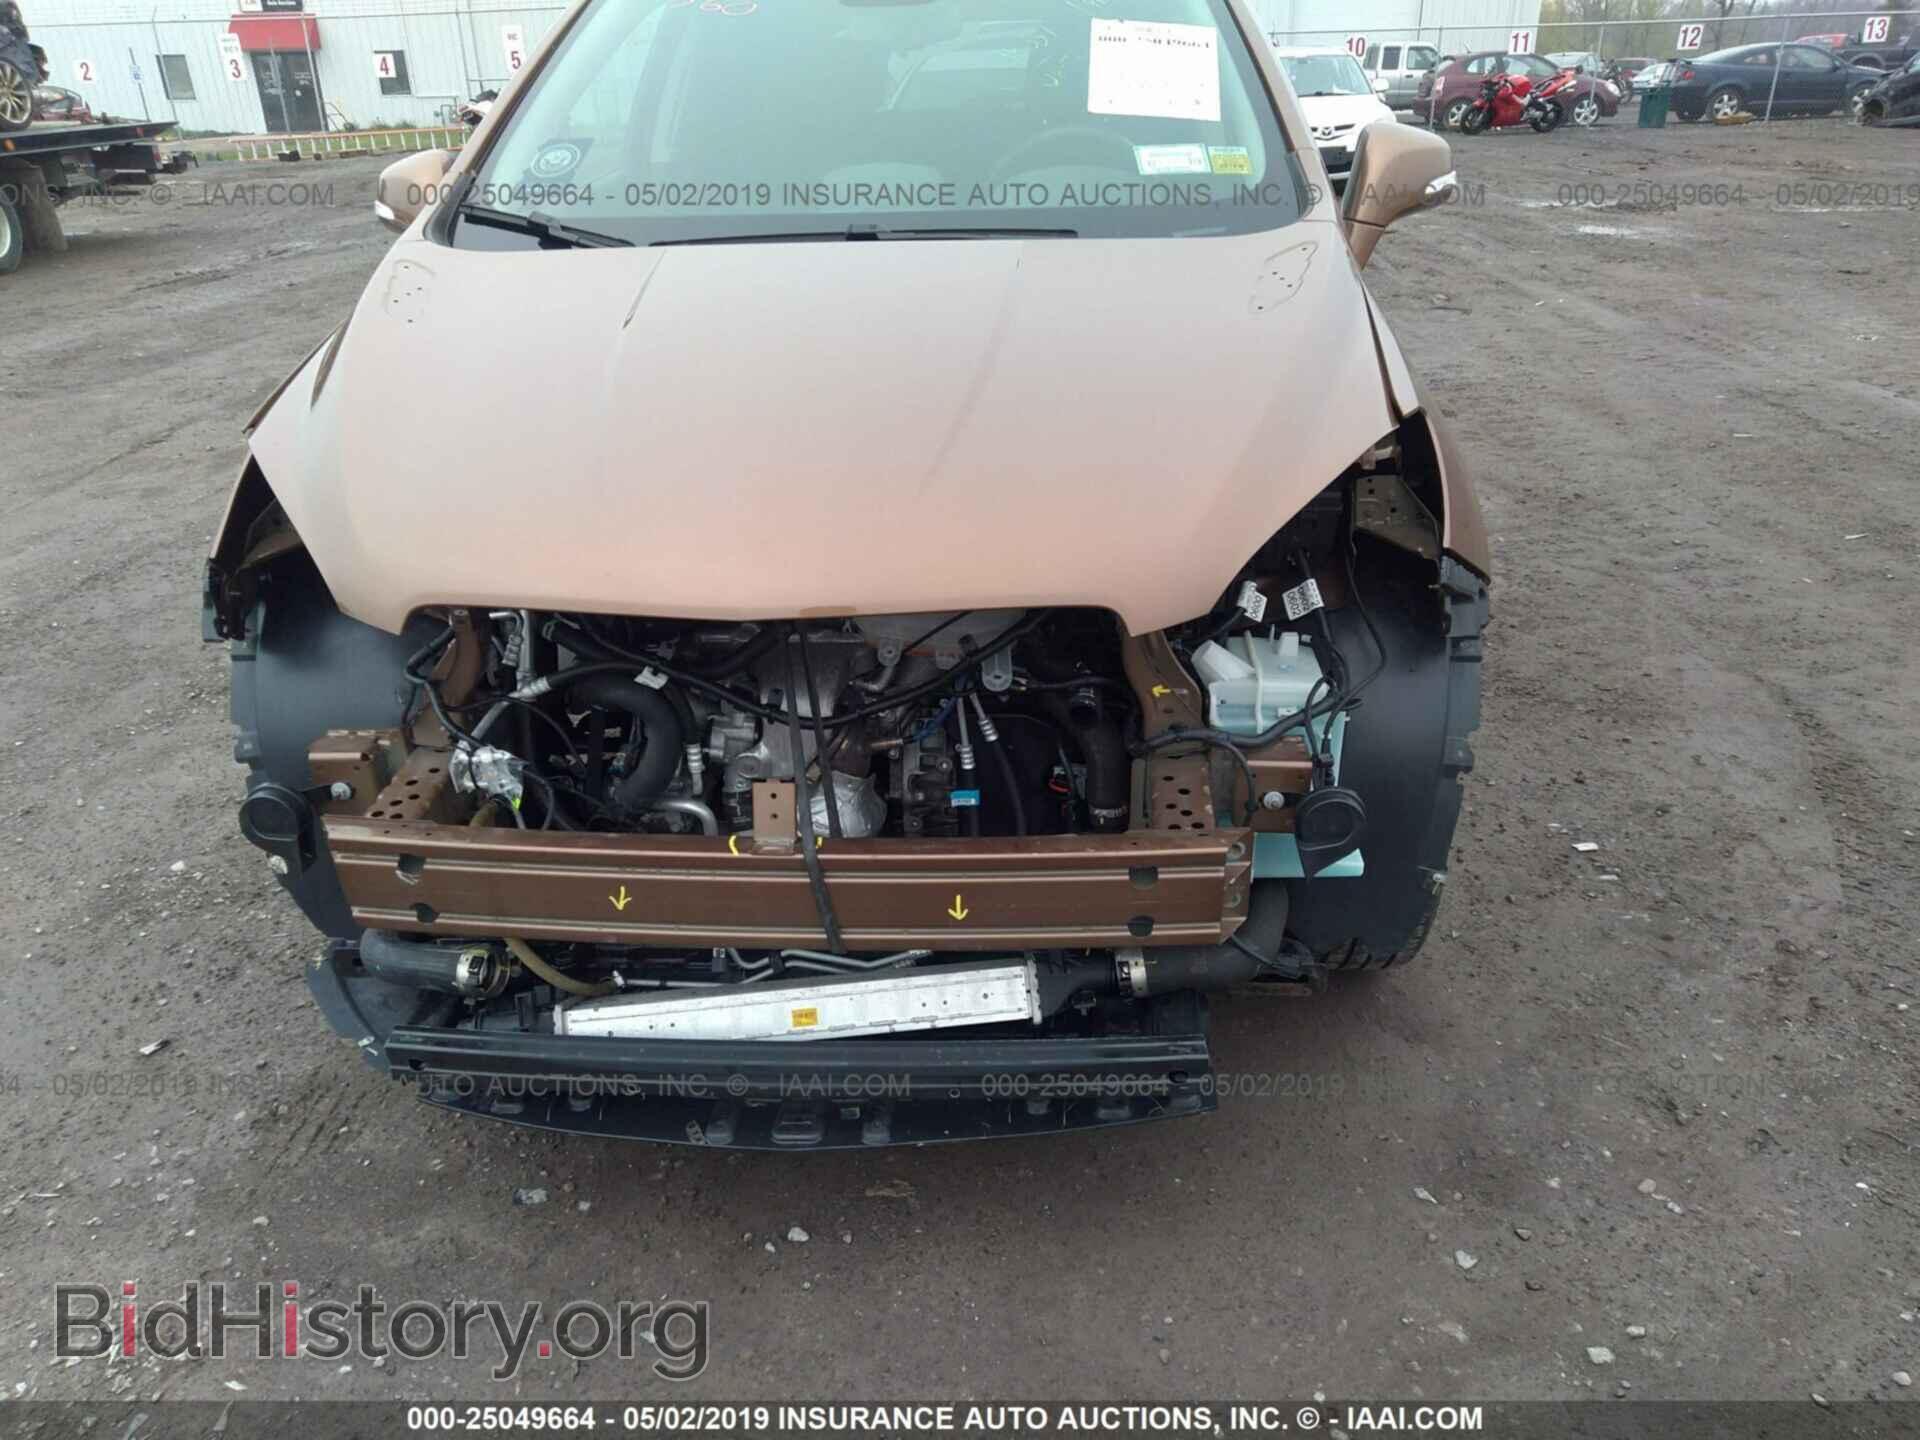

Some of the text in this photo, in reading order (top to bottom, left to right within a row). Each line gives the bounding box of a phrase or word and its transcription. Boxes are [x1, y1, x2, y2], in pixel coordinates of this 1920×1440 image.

[1680, 26, 1701, 47] 12
[1866, 18, 1887, 40] 13
[1346, 37, 1367, 57] 10
[1512, 32, 1529, 53] 11
[230, 59, 241, 78] 3
[380, 56, 390, 75] 4
[511, 51, 521, 69] 5
[80, 61, 93, 81] 2
